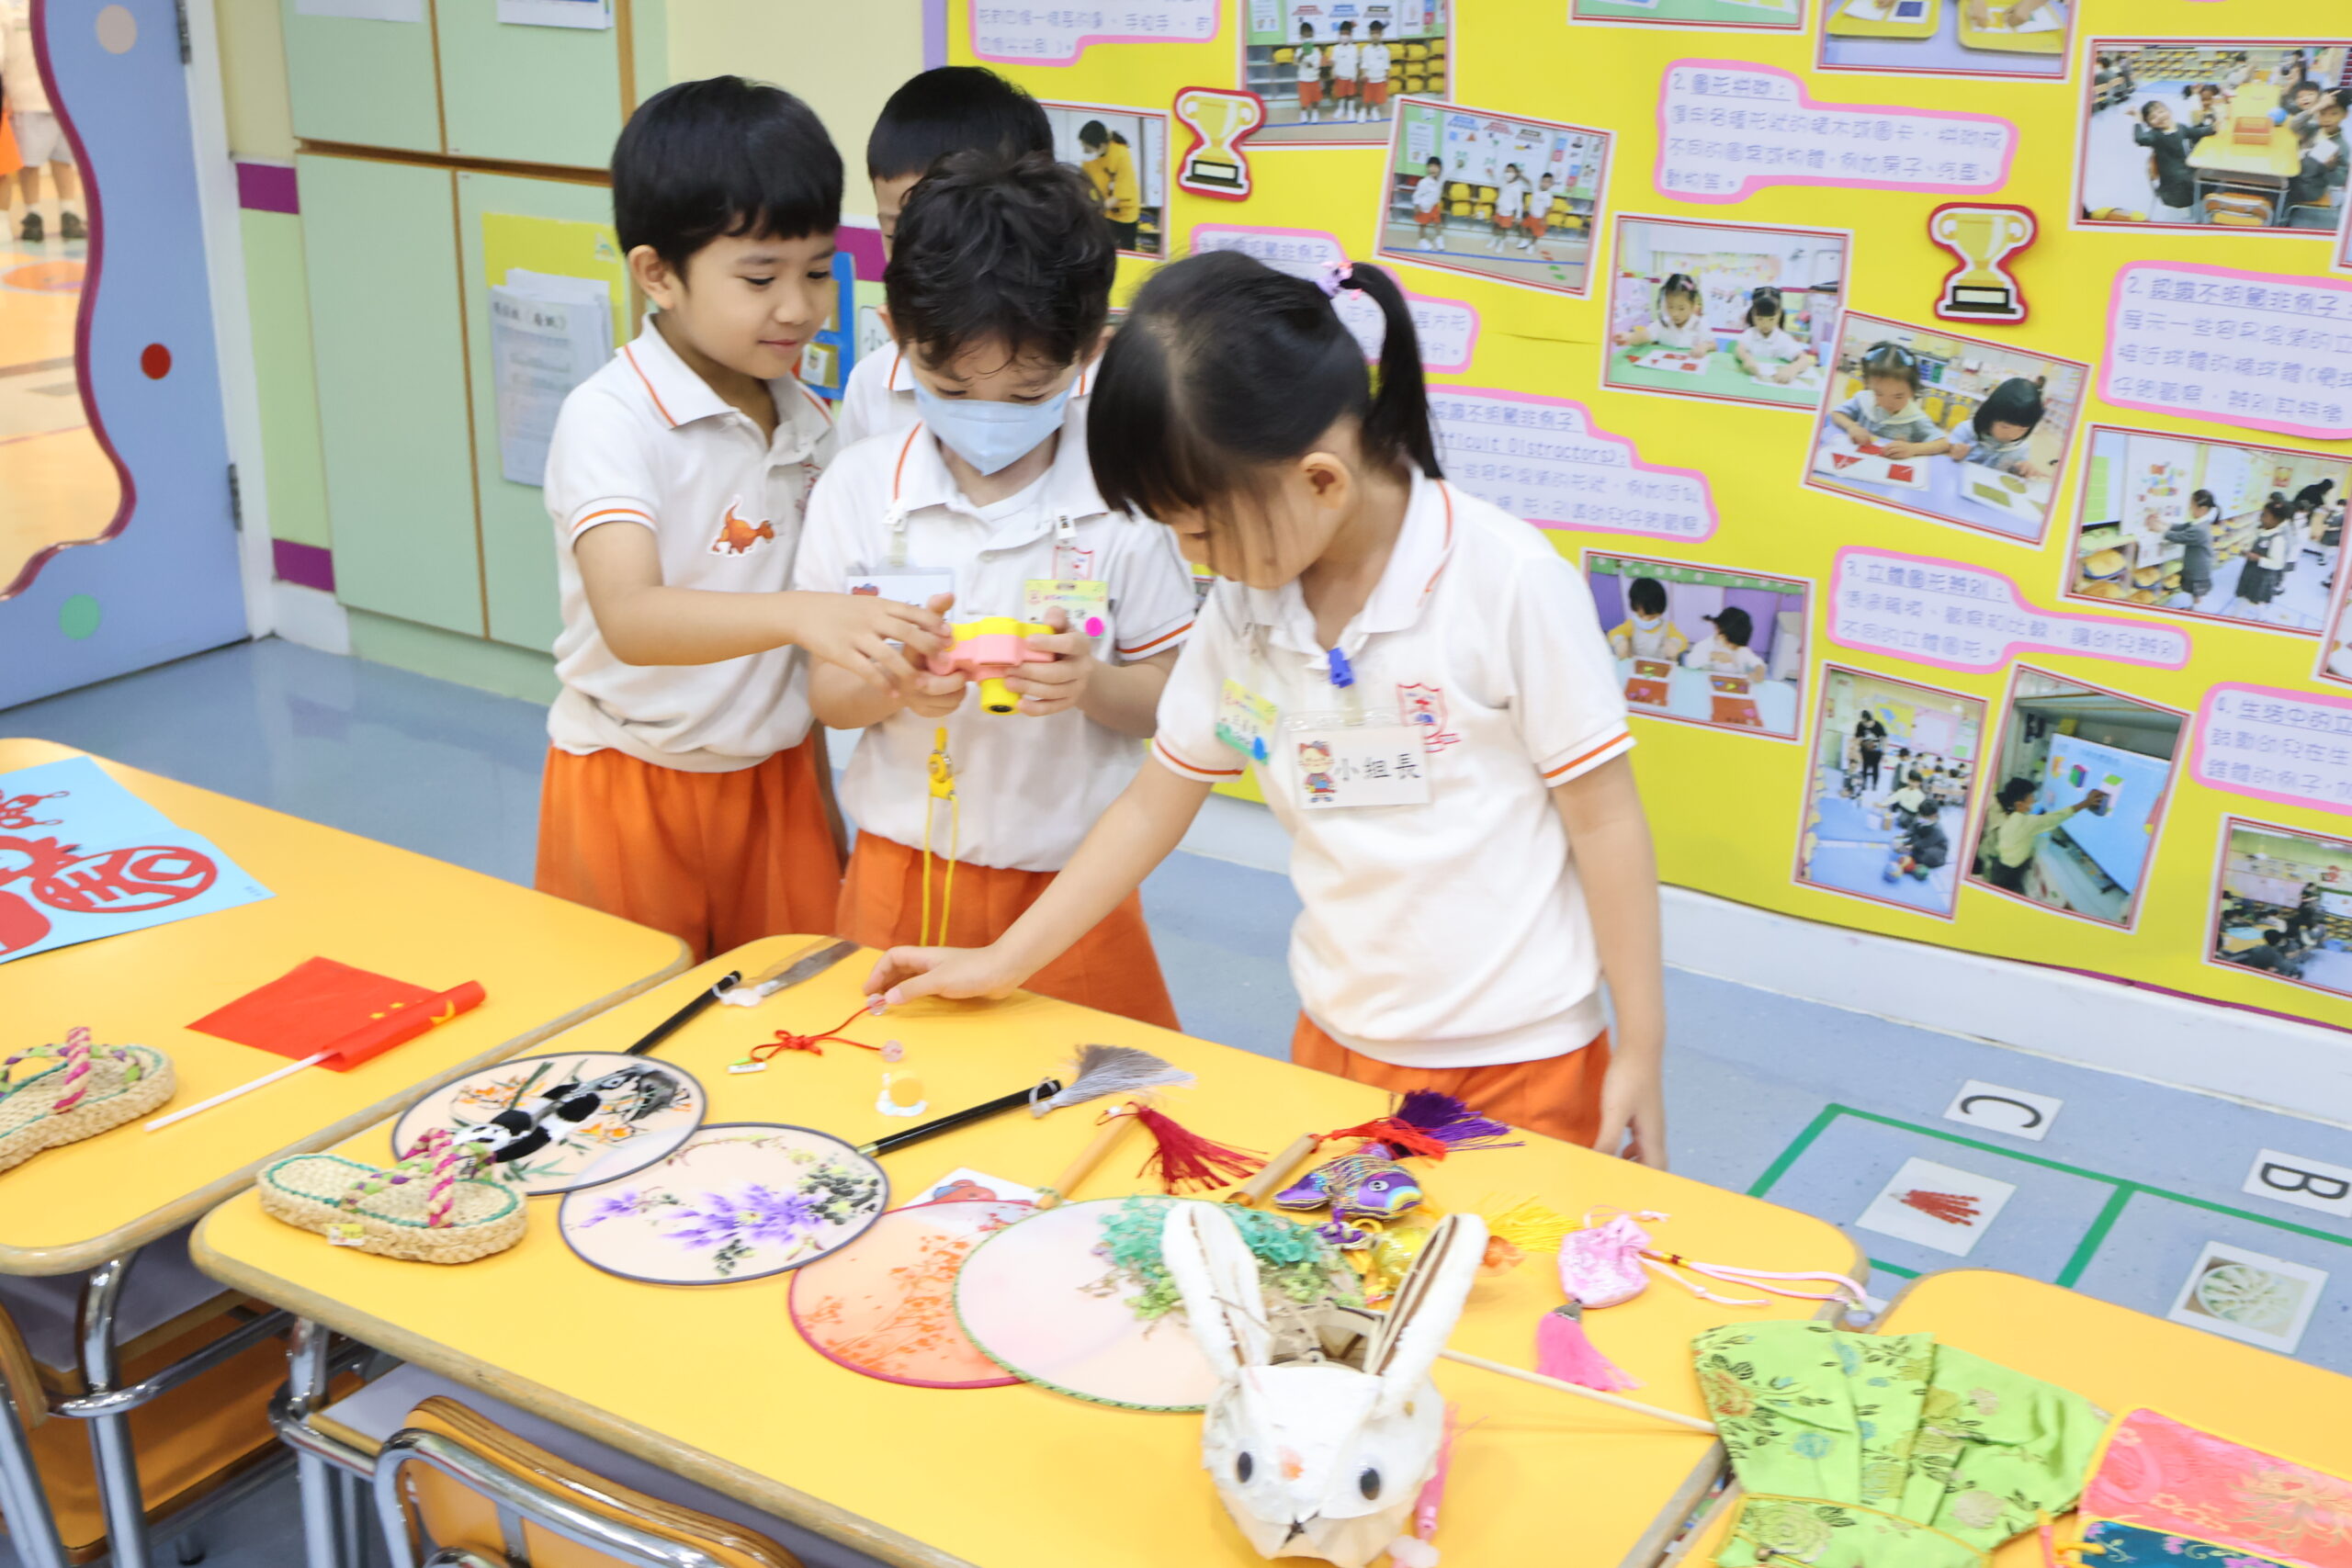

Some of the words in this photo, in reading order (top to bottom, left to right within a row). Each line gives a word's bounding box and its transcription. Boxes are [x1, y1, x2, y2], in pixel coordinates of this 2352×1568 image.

[1334, 751, 1422, 783] 小組長
[1961, 1095, 2041, 1128] C
[2260, 1162, 2350, 1200] B
